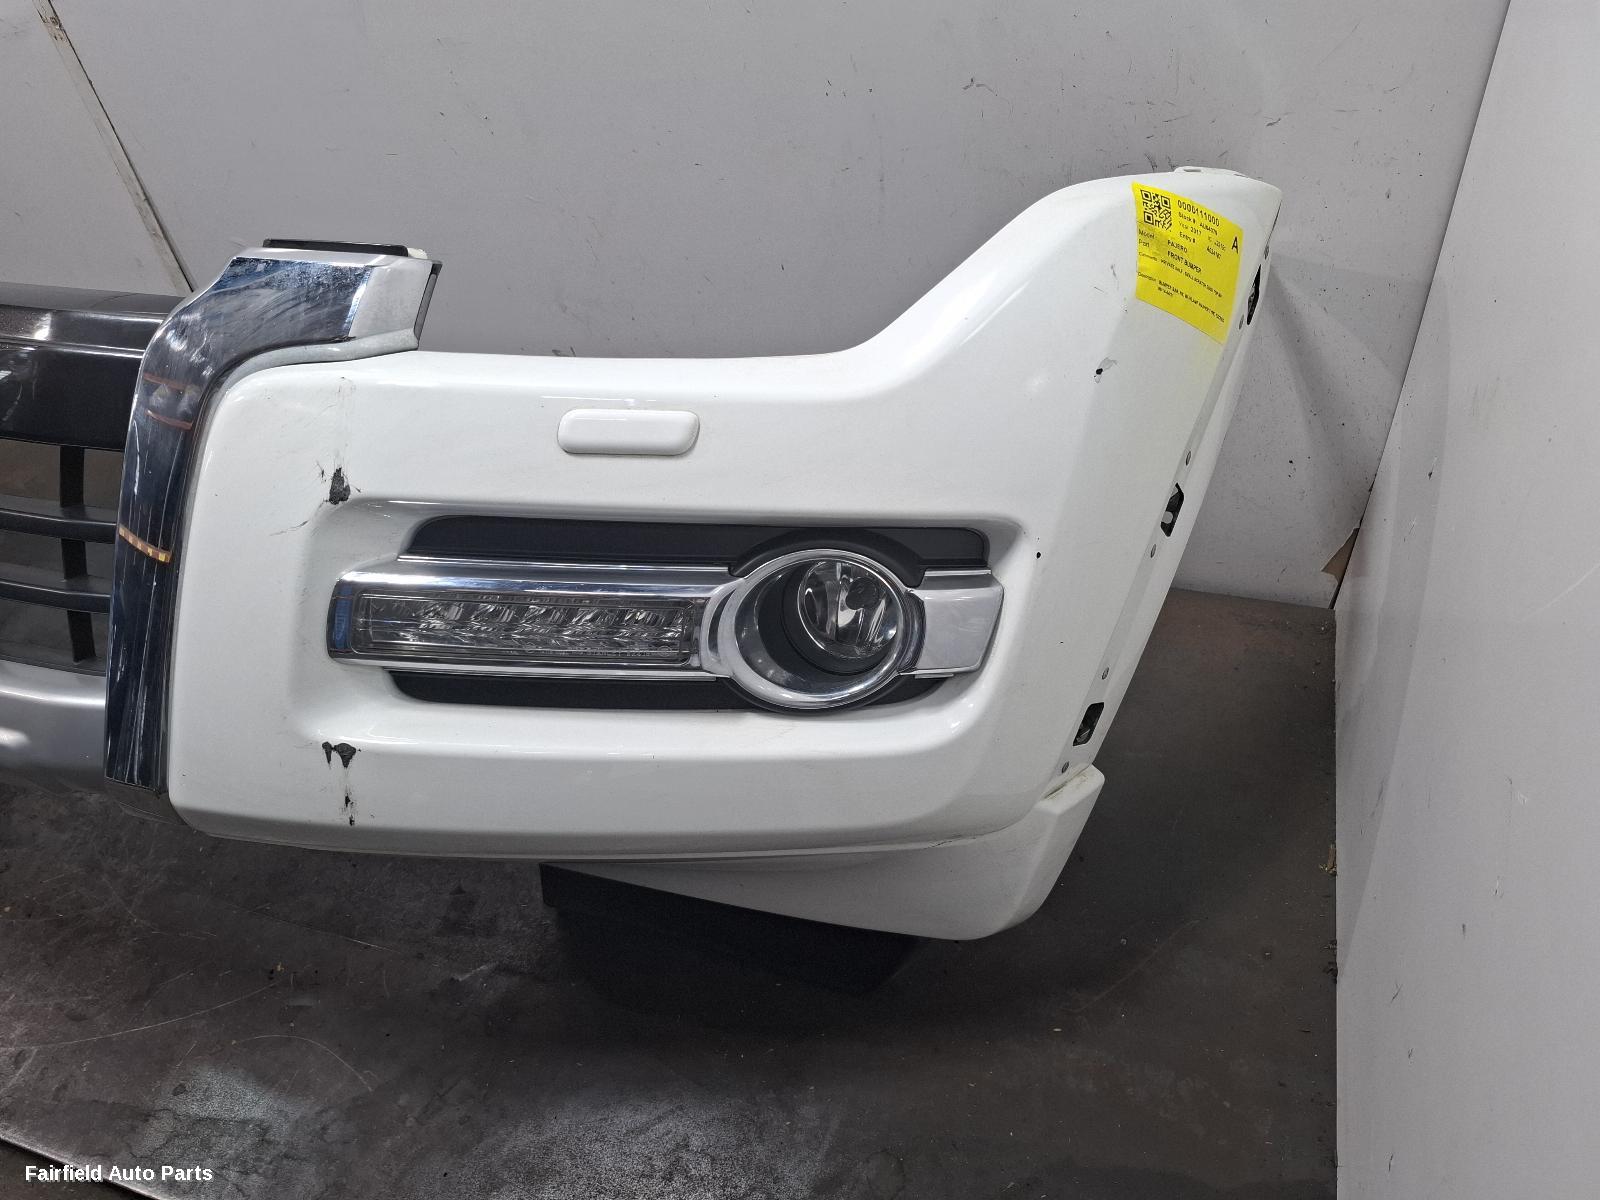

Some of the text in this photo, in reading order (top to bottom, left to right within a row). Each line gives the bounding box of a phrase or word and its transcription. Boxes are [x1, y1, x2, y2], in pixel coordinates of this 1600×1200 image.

[1177, 199, 1220, 227] 0000111000
[1179, 231, 1192, 243] Entry
[1190, 226, 1202, 236] 2017
[1167, 239, 1188, 254] PAJERO
[1231, 236, 1239, 254] A
[1167, 250, 1184, 264] FRONT
[1184, 260, 1202, 273] BUMPER
